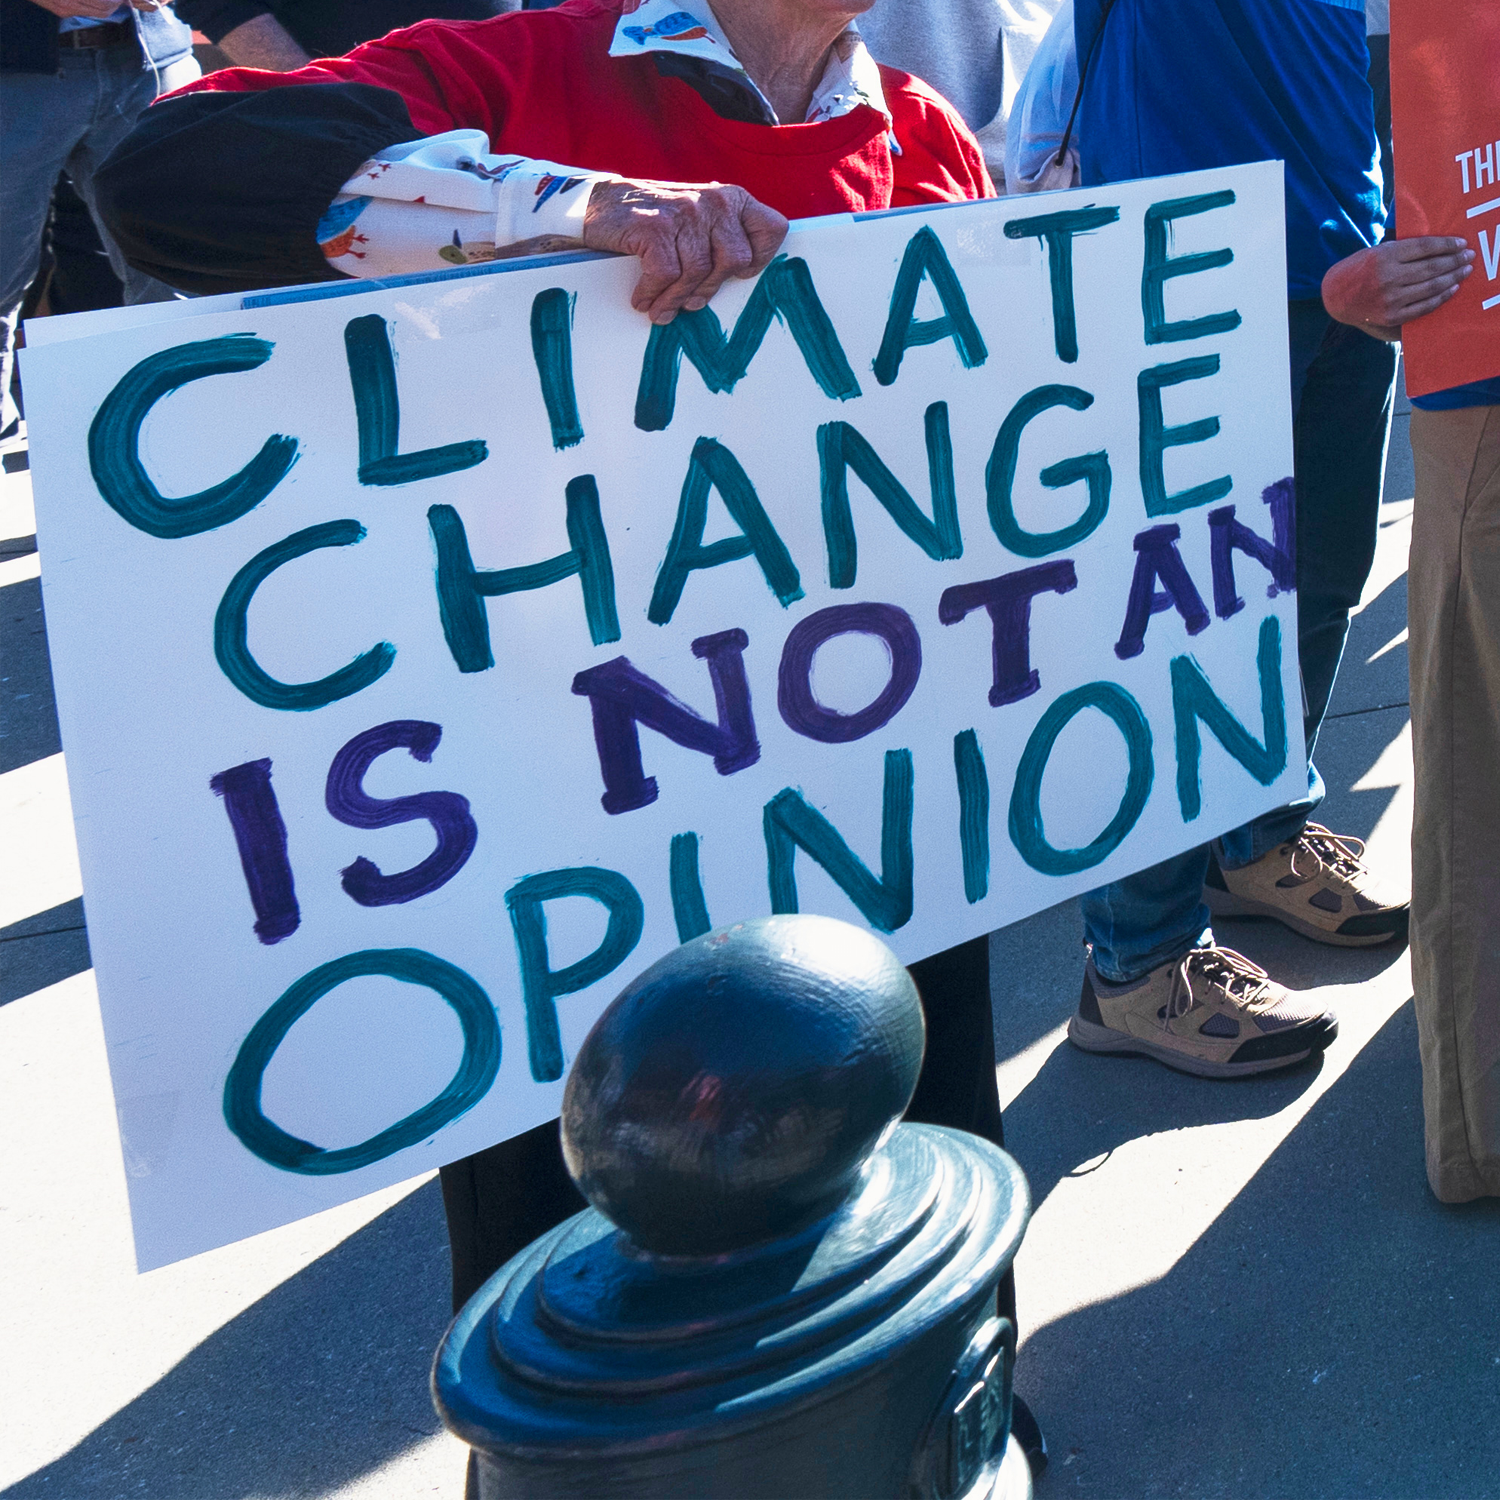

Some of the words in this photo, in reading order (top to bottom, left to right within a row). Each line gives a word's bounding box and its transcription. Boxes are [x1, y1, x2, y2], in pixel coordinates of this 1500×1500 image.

[87, 188, 1243, 540] CLIMATE
[214, 352, 1234, 713] CHANGE
[210, 718, 479, 947] IS
[572, 558, 1078, 816] NOT
[1115, 475, 1297, 661] AN
[223, 614, 1289, 1177] OPINION
